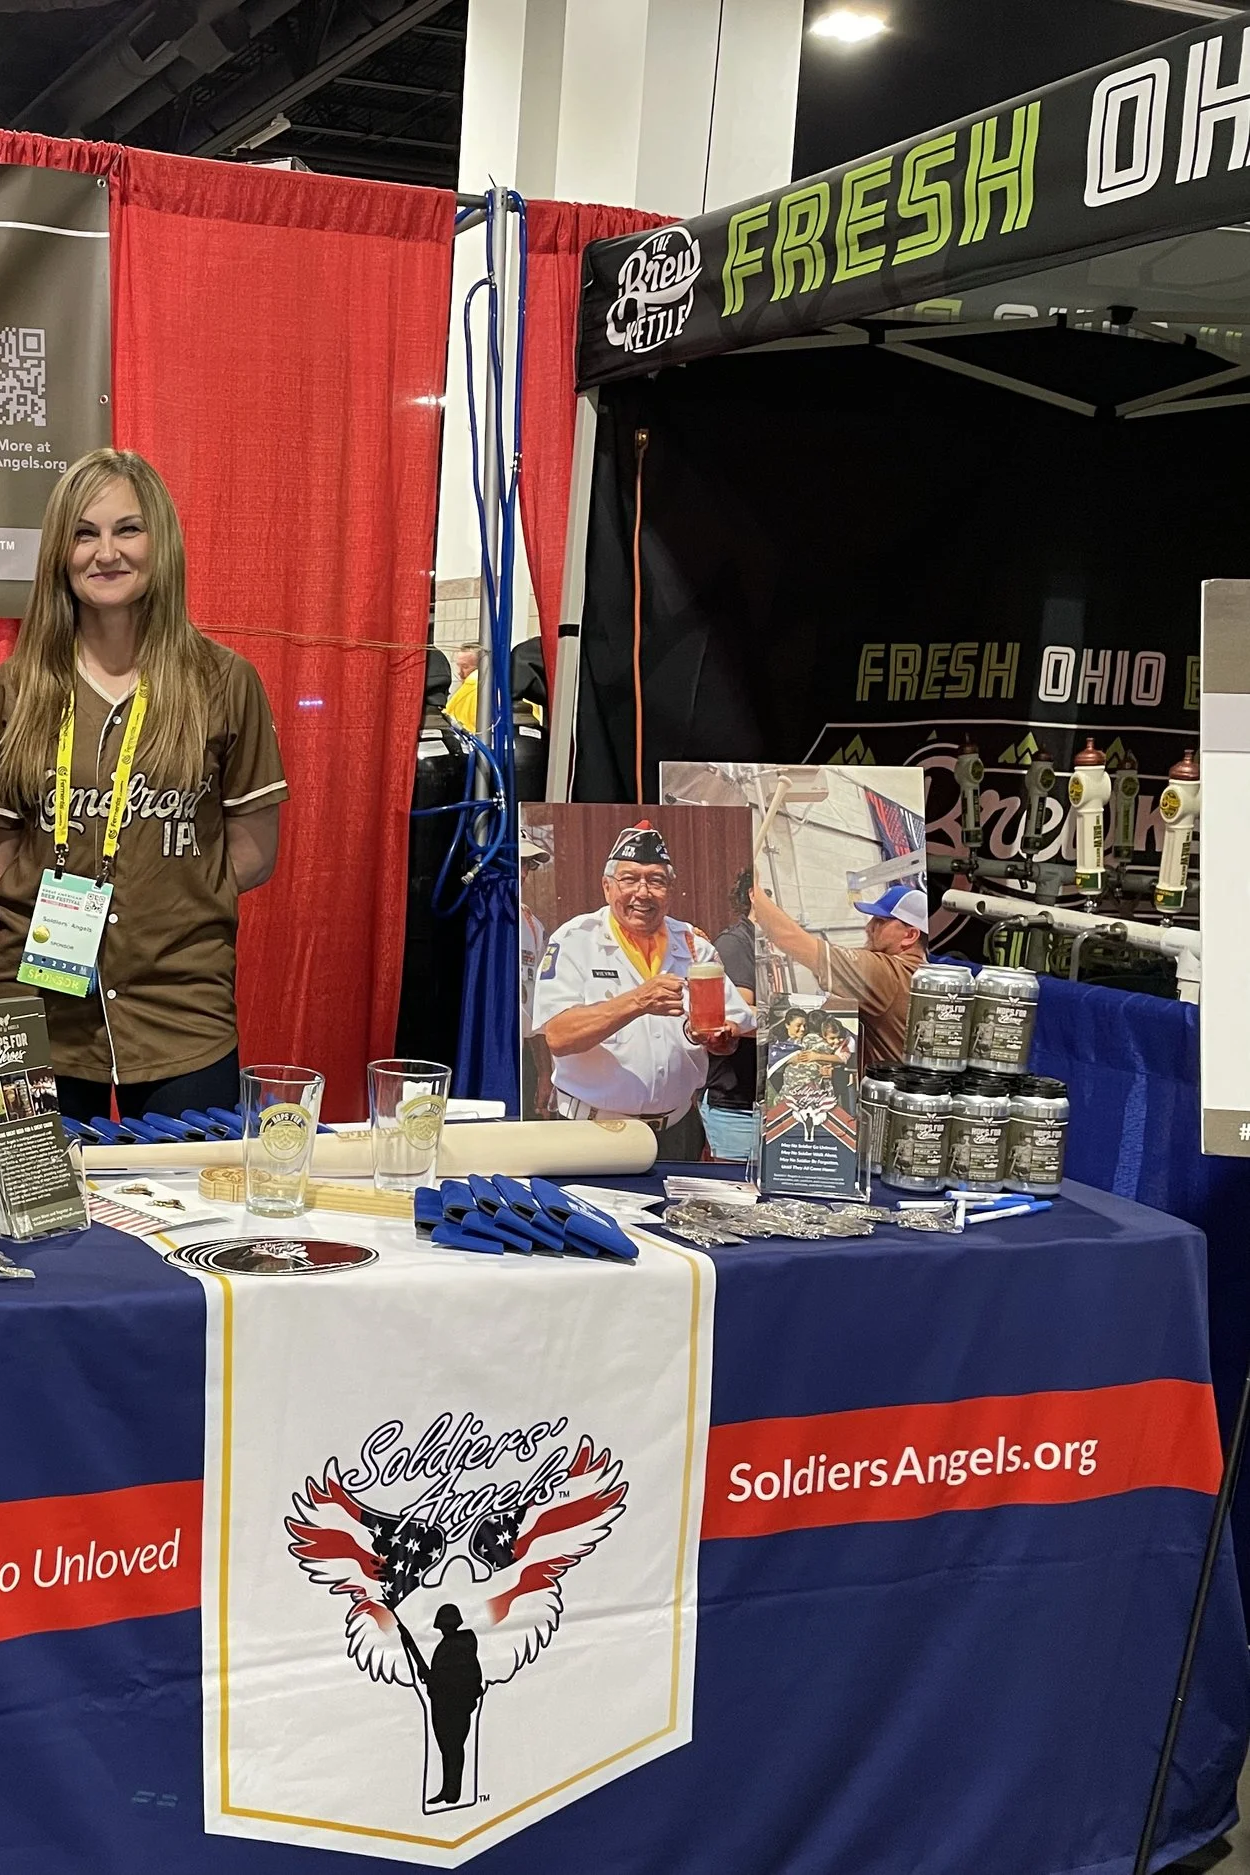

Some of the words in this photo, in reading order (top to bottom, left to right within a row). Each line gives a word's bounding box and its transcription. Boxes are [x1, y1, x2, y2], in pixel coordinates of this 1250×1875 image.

[721, 100, 1041, 317] FRESH
[652, 234, 672, 255] THE
[607, 239, 703, 320] Brew
[624, 304, 687, 352] KETTLE
[37, 440, 51, 453] at
[856, 642, 1021, 702] FRESH
[1038, 645, 1166, 707] OHIO
[71, 923, 92, 933] Angels
[27, 969, 79, 989] SPONSOR
[10, 1032, 29, 1049] FOR
[271, 1113, 290, 1124] HOPS
[341, 1412, 568, 1492] Soldiers'
[726, 1433, 1098, 1505] SoldiersAngels.org
[393, 1446, 569, 1544] Angels
[33, 1527, 182, 1589] Unloved
